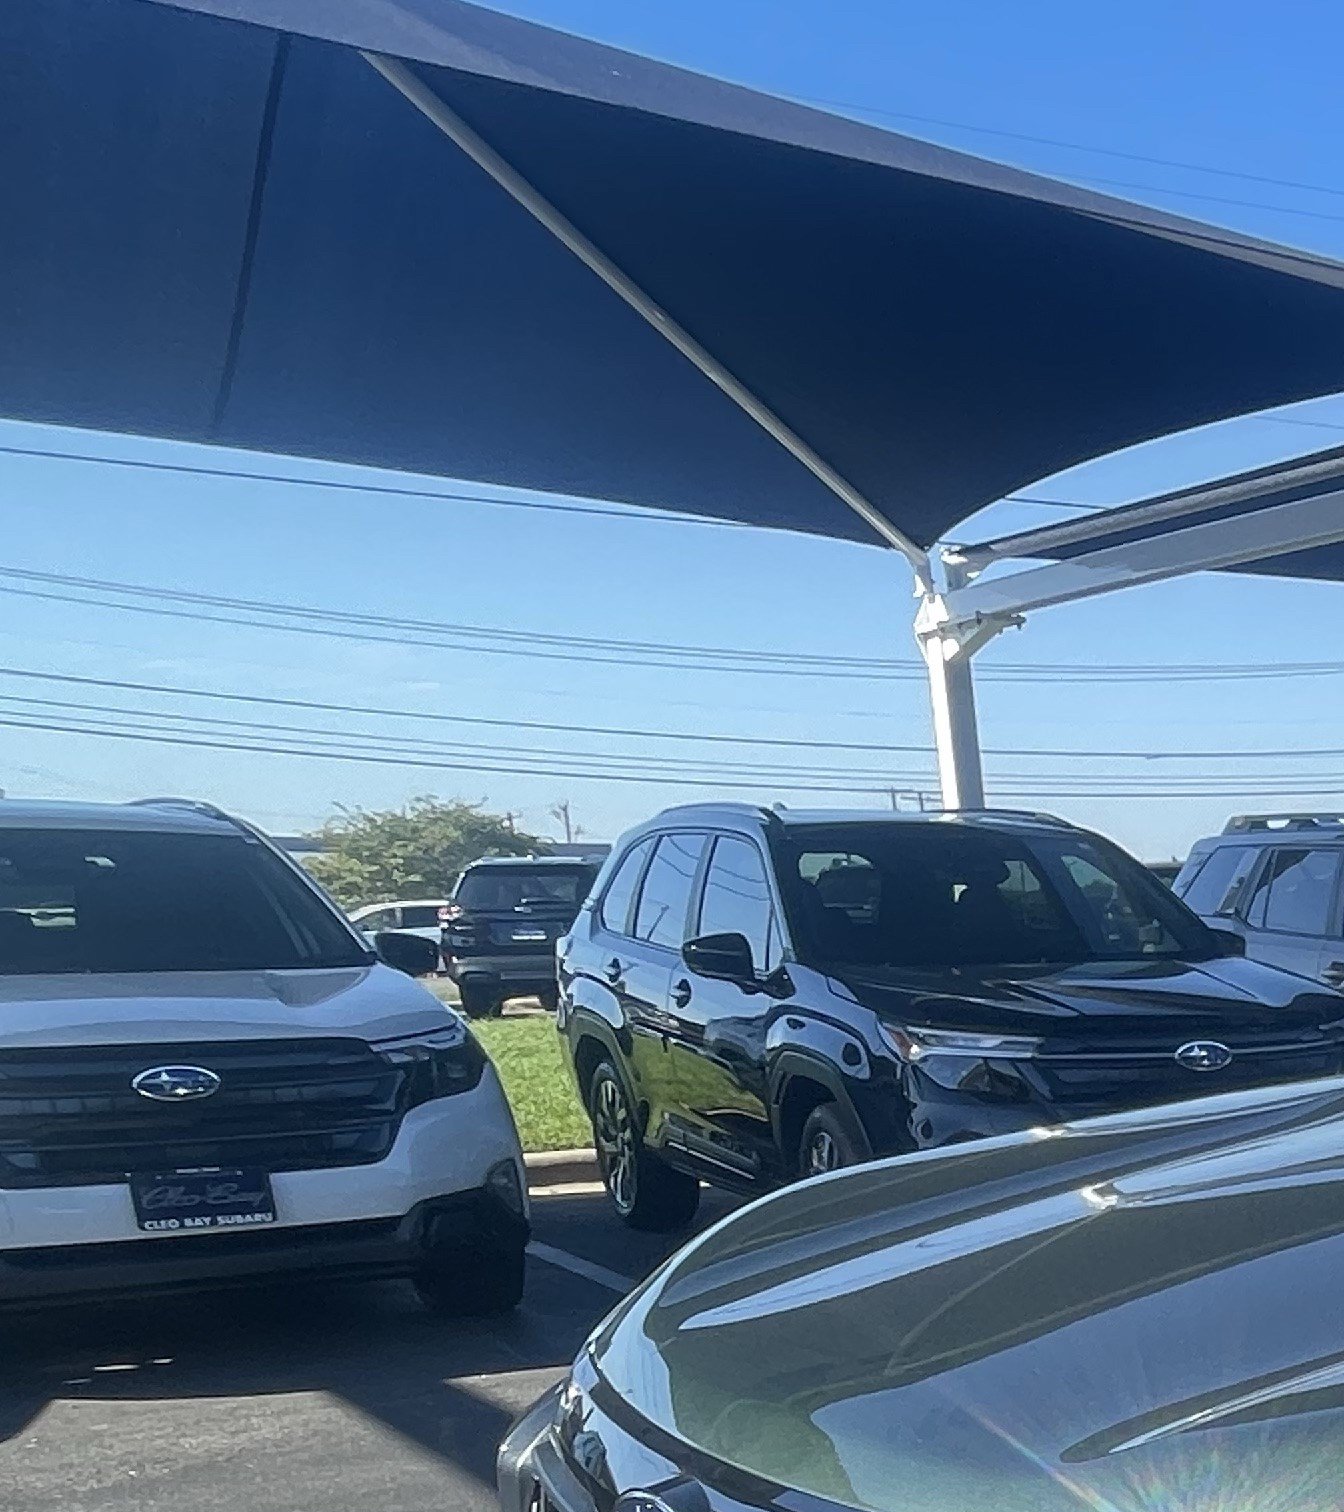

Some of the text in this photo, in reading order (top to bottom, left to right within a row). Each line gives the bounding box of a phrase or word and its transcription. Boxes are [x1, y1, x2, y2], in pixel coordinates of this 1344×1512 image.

[144, 1212, 273, 1231] CLEO BAY SUBARU
